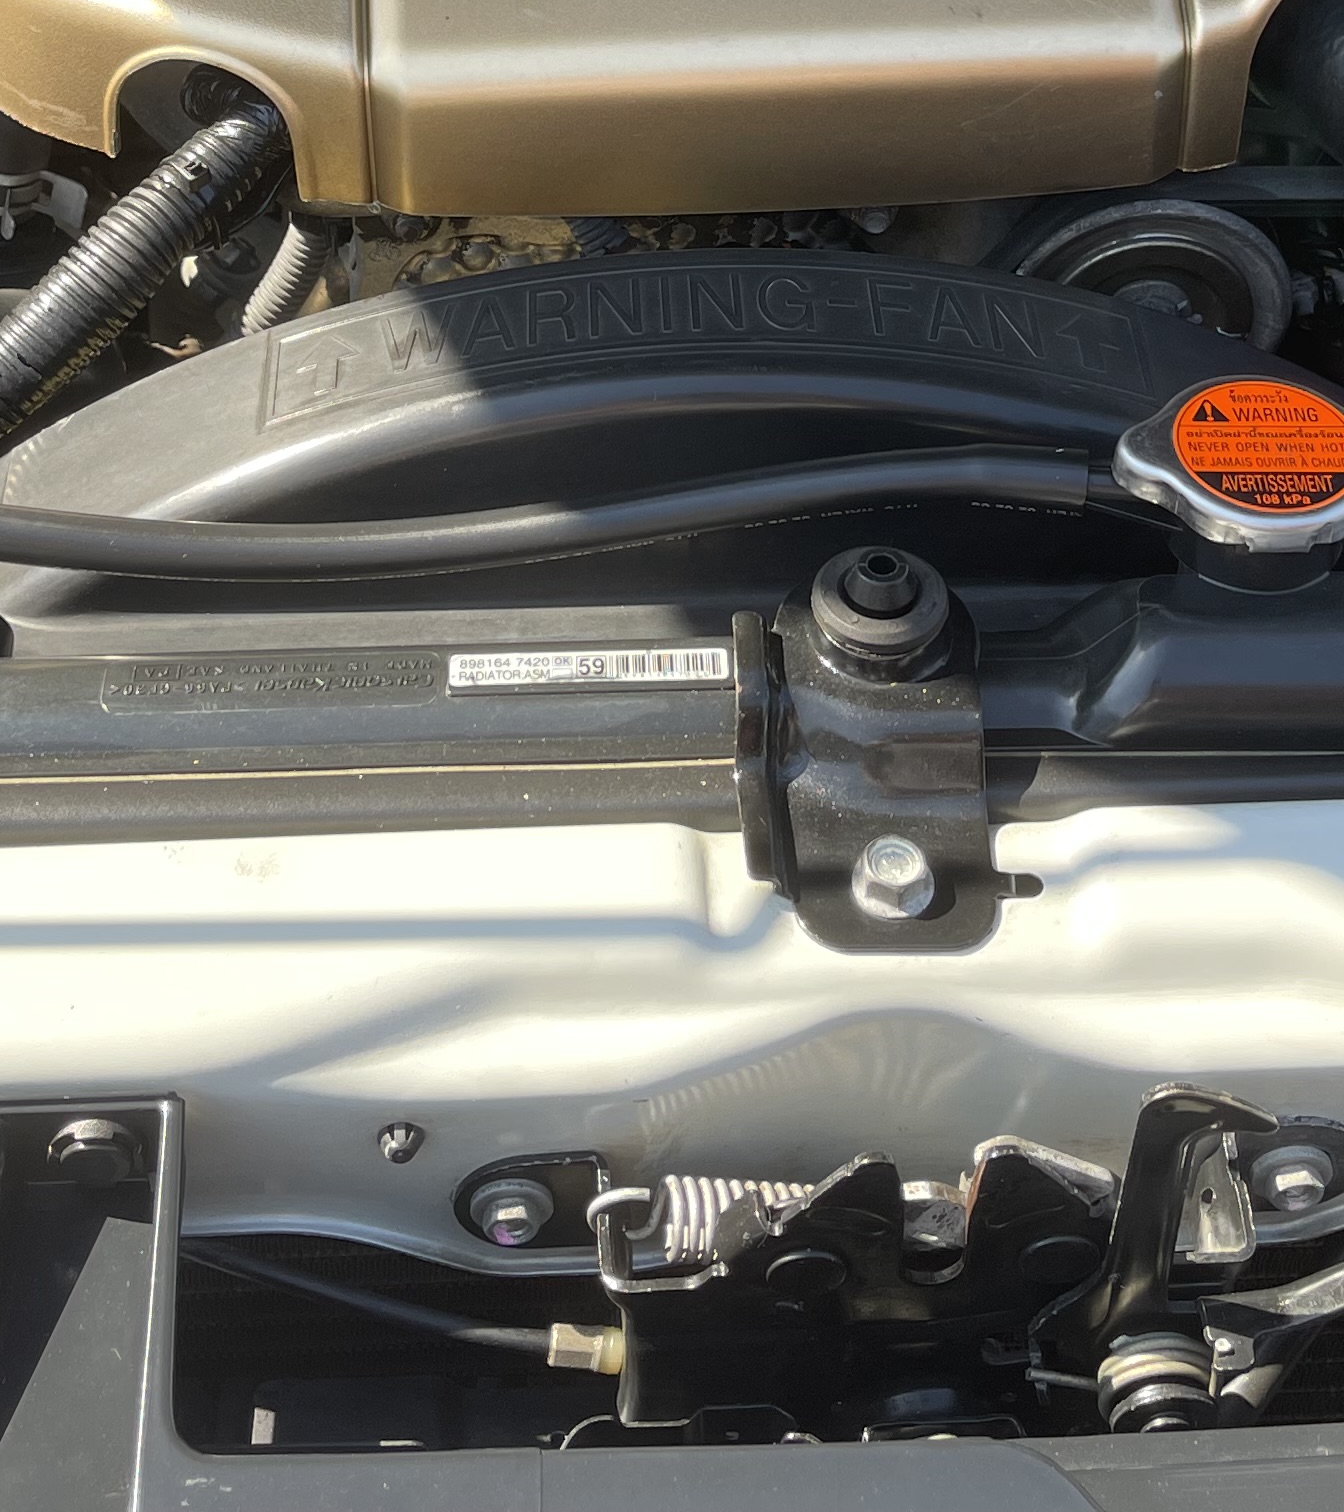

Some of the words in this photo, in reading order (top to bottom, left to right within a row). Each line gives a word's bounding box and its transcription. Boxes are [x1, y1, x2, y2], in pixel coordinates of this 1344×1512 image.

[1231, 407, 1320, 422] WARNING
[1188, 441, 1230, 453] NEVER
[1235, 441, 1270, 452] OPEN
[1274, 441, 1315, 453] WHEN
[1191, 455, 1206, 468] NE
[1210, 455, 1253, 468] JAMAIS
[1256, 456, 1296, 468] OUVRIR
[1300, 454, 1308, 468] À
[1221, 474, 1334, 493] AVERTISSEMENT
[1253, 494, 1281, 505] 108
[1284, 493, 1312, 506] kPa
[239, 661, 335, 675] THAILAND
[386, 659, 433, 671] MADE
[459, 658, 511, 670] 898164
[516, 656, 551, 668] 7420
[553, 656, 571, 666] OK
[577, 657, 605, 676] 59
